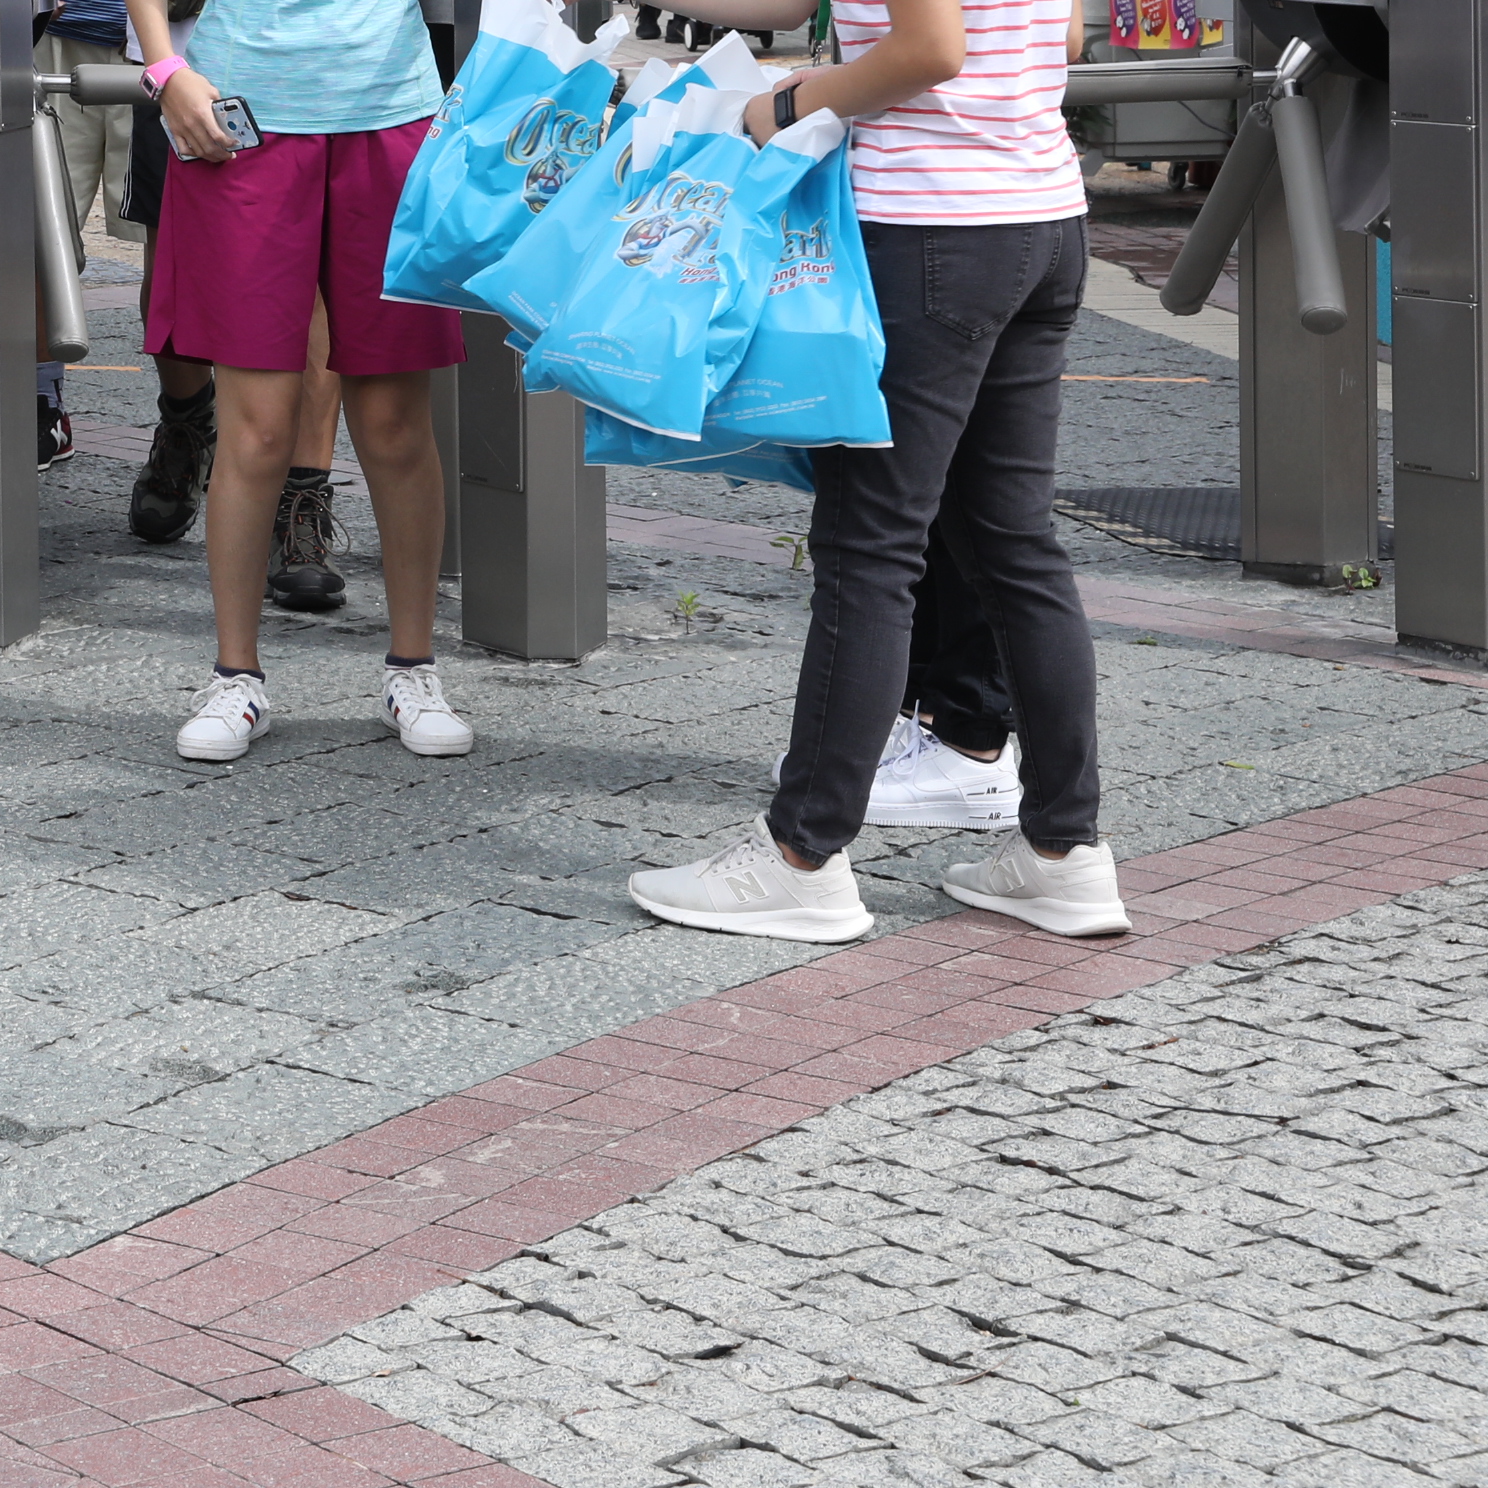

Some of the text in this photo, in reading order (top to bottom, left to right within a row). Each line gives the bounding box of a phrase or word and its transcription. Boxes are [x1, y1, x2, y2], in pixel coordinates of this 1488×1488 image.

[986, 787, 997, 795] AIR
[988, 812, 1001, 820] AIR
[723, 870, 769, 904] N
